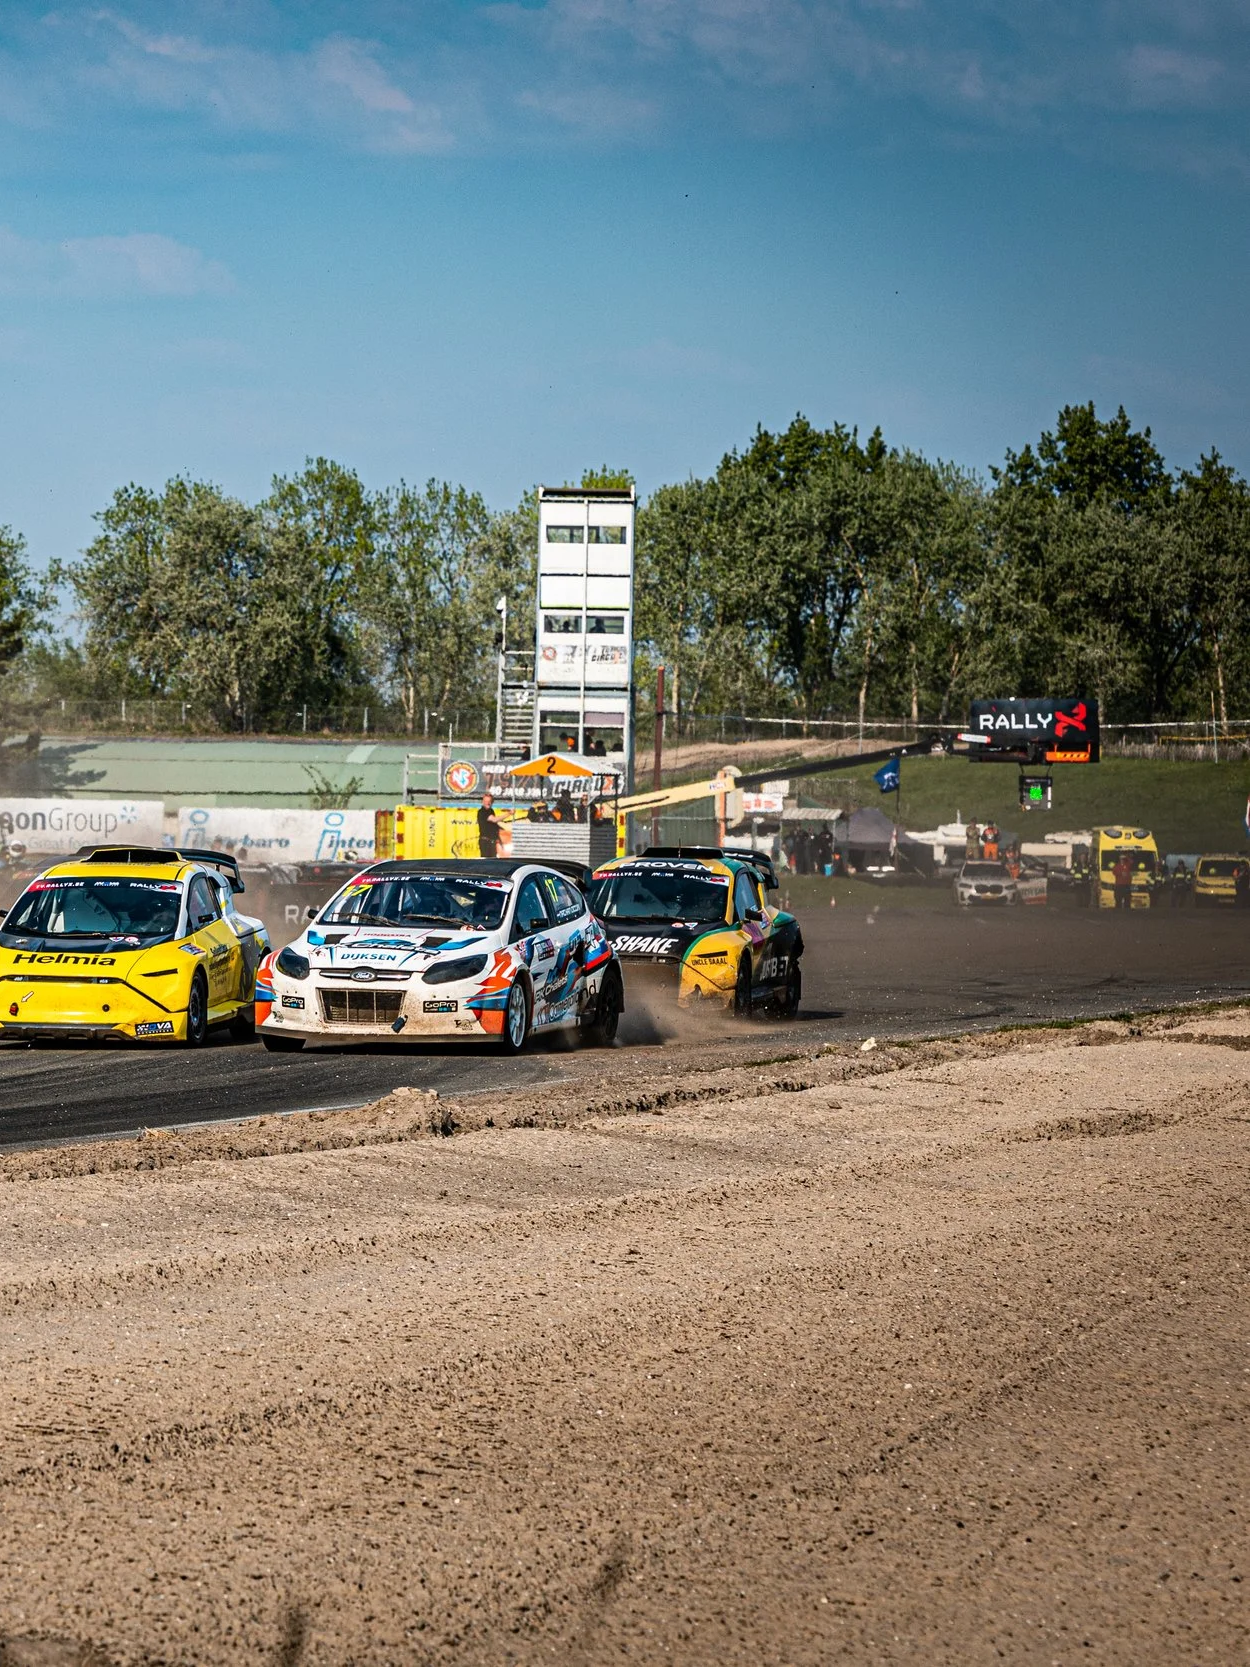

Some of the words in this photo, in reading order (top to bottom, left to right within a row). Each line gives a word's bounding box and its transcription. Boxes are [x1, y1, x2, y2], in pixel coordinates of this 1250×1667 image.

[546, 756, 557, 774] 2
[328, 835, 374, 848] inter
[619, 862, 713, 871] PROVEN
[544, 880, 559, 903] 17
[613, 935, 679, 954] SHAKE
[12, 953, 117, 966] Helmia
[341, 953, 397, 962] DIJKSEN
[691, 958, 707, 966] UNCLE
[355, 971, 375, 980] Ford
[283, 996, 304, 1004] GoPro
